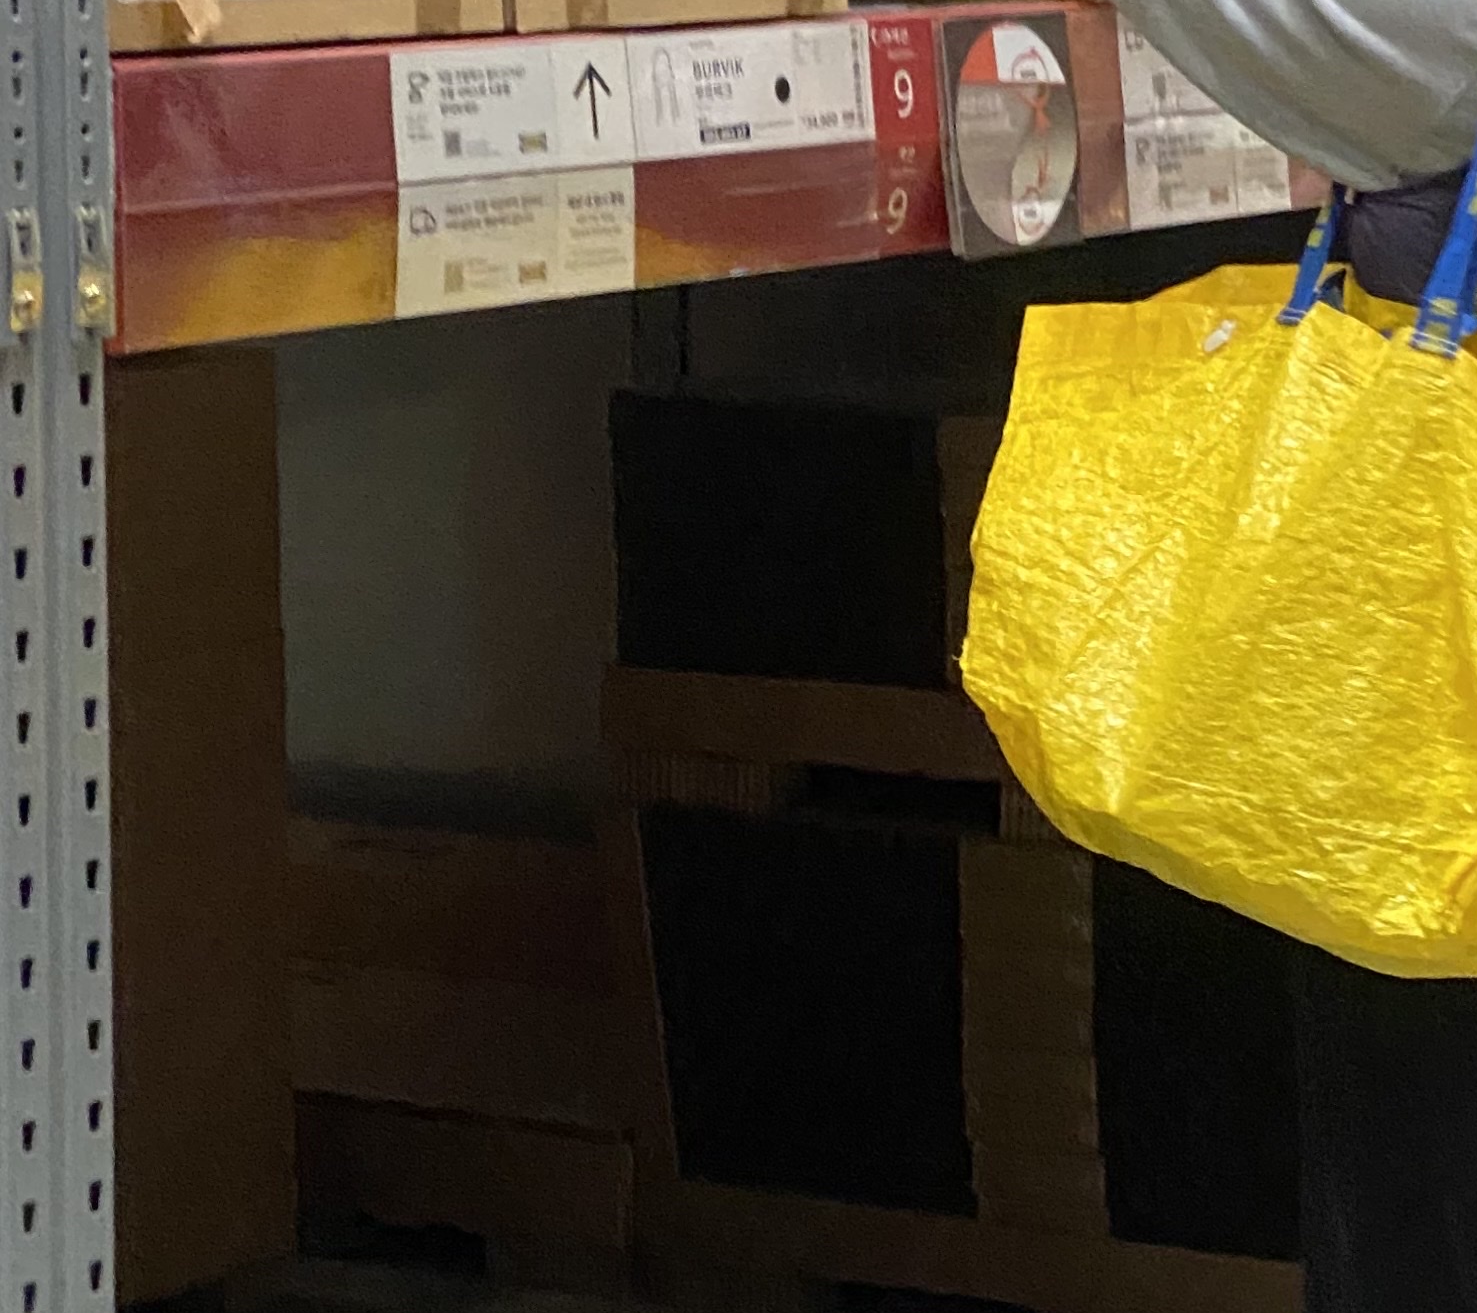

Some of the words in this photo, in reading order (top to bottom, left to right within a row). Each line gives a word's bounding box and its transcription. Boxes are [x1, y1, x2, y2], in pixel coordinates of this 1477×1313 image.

[692, 57, 746, 80] BURVIK
[894, 68, 914, 119] 9
[886, 186, 908, 235] 9
